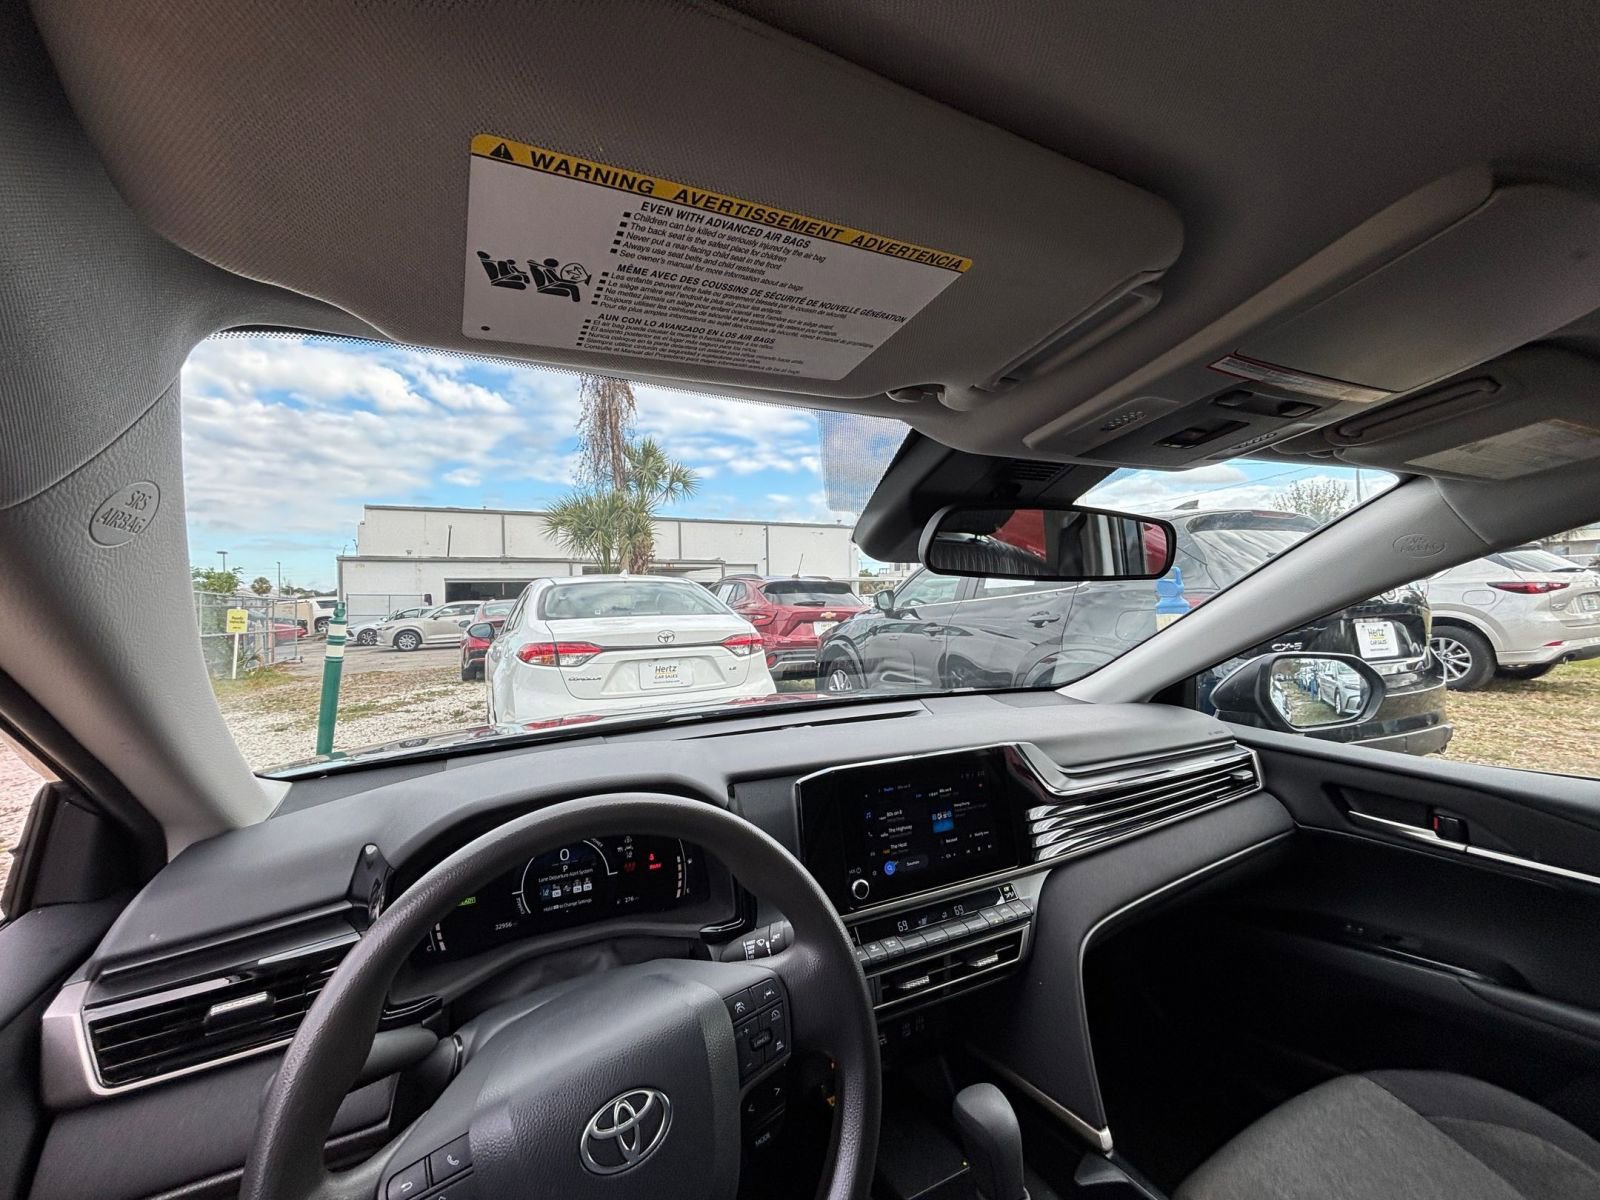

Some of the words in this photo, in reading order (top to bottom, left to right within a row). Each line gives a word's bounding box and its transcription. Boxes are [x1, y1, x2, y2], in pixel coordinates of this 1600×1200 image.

[530, 150, 656, 196] WARNING
[672, 188, 845, 241] AVERTISSEMENT
[851, 235, 964, 272] ADVERTENCIA
[640, 201, 674, 216] EVEN
[676, 209, 705, 224] WITH
[705, 217, 763, 237] ADVANCED
[762, 231, 782, 242] AIR
[782, 235, 811, 248] BAGS
[625, 231, 650, 242] Never
[650, 238, 665, 246] put
[672, 242, 712, 257] rear-facing
[712, 250, 730, 259] child
[729, 254, 746, 262] seat
[765, 261, 782, 270] front
[630, 221, 646, 232] The
[647, 226, 667, 237] back
[667, 232, 686, 240] seat
[685, 234, 694, 242] is
[694, 236, 707, 245] the
[707, 240, 730, 250] safest
[728, 245, 750, 254] place
[749, 248, 760, 256] for
[760, 251, 787, 262] children
[633, 212, 668, 226] Children
[668, 222, 684, 230] can
[684, 223, 696, 233] be
[696, 226, 718, 237] killed
[726, 234, 758, 248] seriously
[758, 241, 784, 252] injured
[782, 246, 792, 256] by
[812, 253, 826, 263] bag
[619, 249, 635, 259] See
[636, 254, 665, 264] owner's
[666, 260, 694, 270] manual
[694, 263, 705, 272] for
[704, 267, 723, 276] more
[723, 270, 760, 282] information
[759, 278, 779, 286] about
[787, 283, 803, 291] bags
[622, 241, 650, 253] Always
[667, 251, 684, 259] seat
[684, 253, 702, 263] belts
[717, 260, 736, 269] child
[734, 265, 765, 275] restraints
[616, 263, 649, 276] MÊME
[649, 270, 678, 281] AVEC
[679, 275, 700, 285] DES
[701, 279, 749, 294] COUSSINS
[749, 288, 764, 297] DE
[763, 291, 807, 304] SÉCURITÉ
[805, 299, 820, 307] DE
[818, 301, 861, 314] NOUVELLE
[859, 309, 907, 323] GÉNÉRATION
[597, 313, 619, 322] AUN
[621, 316, 642, 325] CON
[657, 322, 705, 334] AVANZADO
[719, 330, 737, 338] LOS
[752, 336, 775, 344] BAGS
[125, 490, 152, 512] SRS
[96, 507, 146, 534] AIRBAG
[1271, 642, 1303, 652] CX-5
[1367, 628, 1384, 638] Hertz
[655, 664, 678, 674] Hertz
[560, 848, 570, 861] 0
[954, 904, 964, 916] 69
[897, 920, 908, 932] 69
